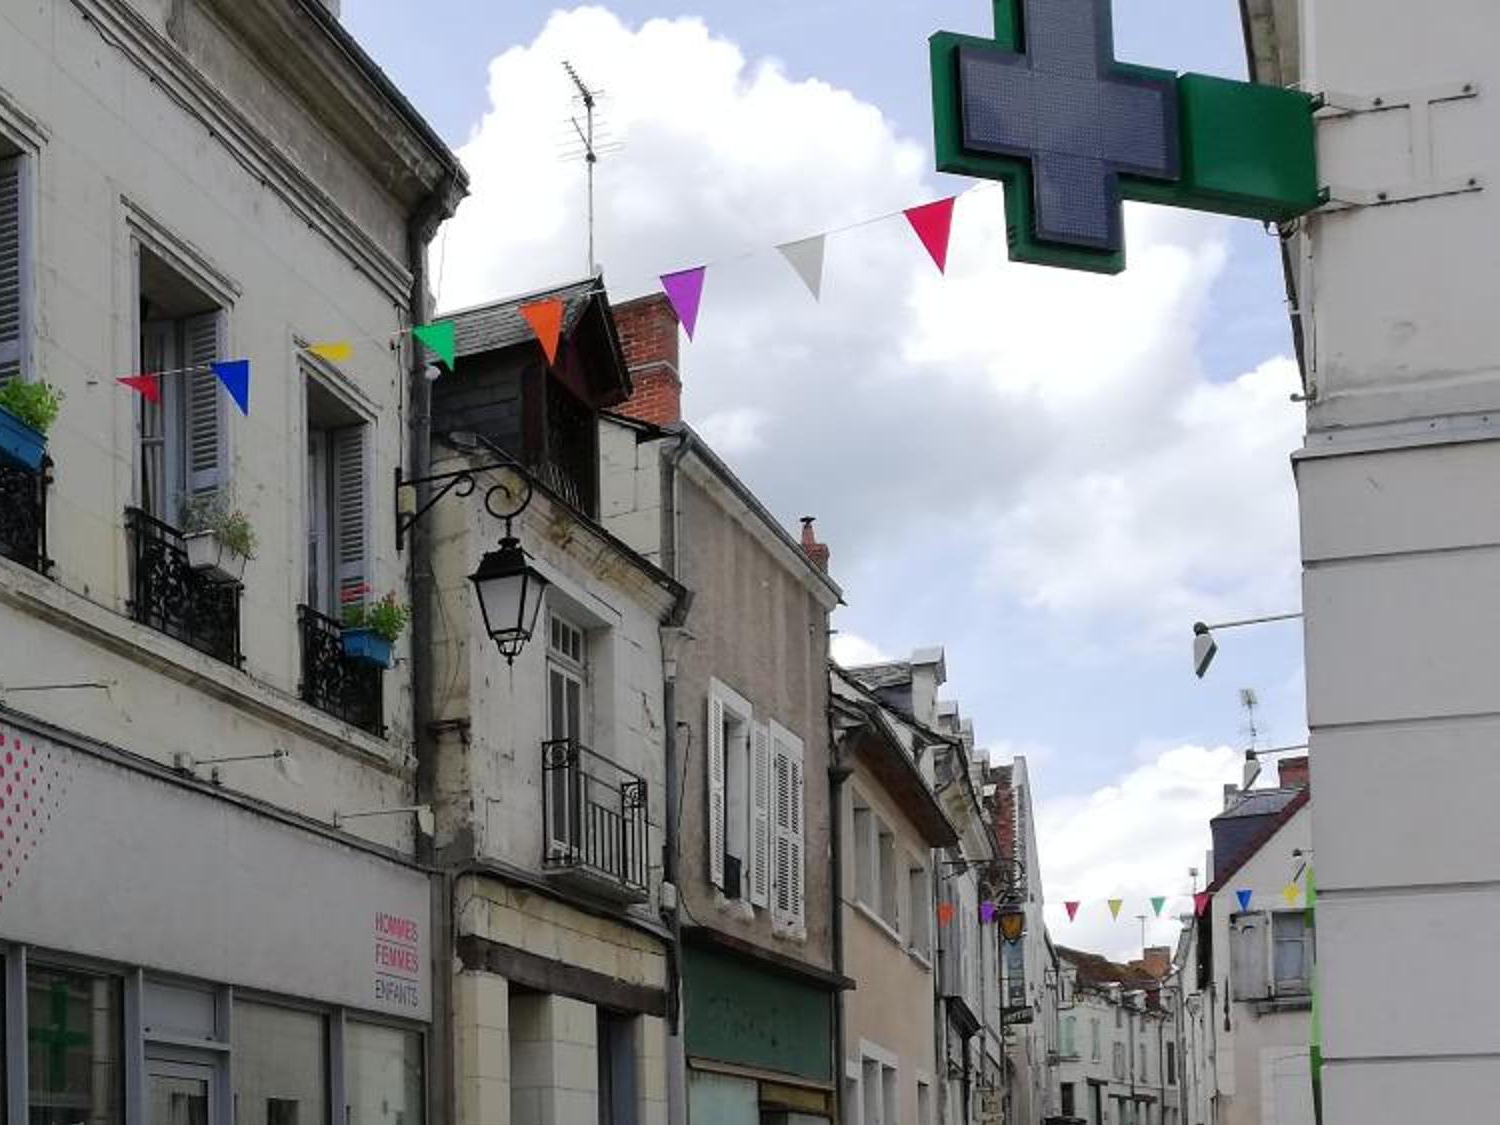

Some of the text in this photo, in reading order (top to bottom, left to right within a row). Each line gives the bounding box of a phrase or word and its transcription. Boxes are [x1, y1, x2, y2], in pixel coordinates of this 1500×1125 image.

[375, 912, 418, 942] HOMMES
[375, 944, 419, 973] FEMMES
[375, 979, 419, 1007] ENFANTS
